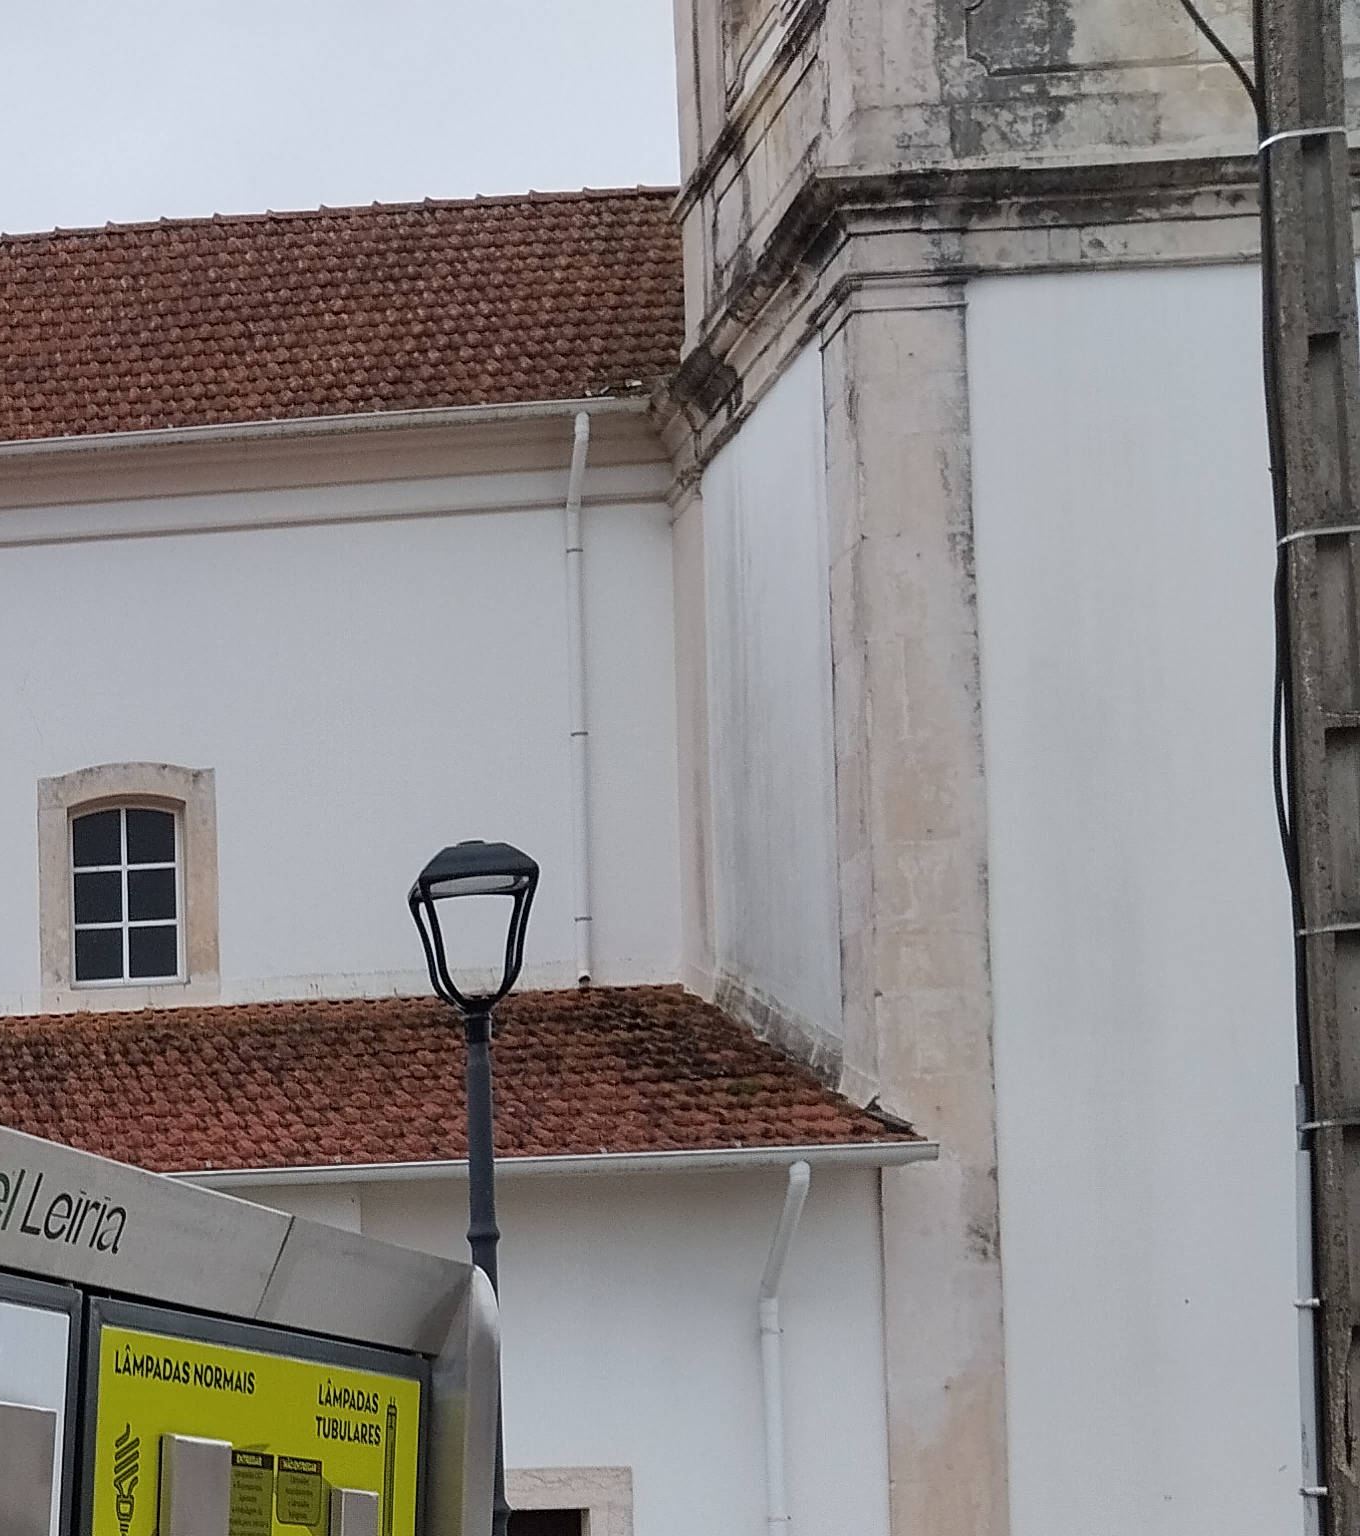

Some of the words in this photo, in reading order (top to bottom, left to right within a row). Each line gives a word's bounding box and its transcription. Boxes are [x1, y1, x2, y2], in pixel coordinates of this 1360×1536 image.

[19, 1169, 128, 1256] Leiria
[114, 1344, 190, 1385] LÂMPADAS
[193, 1364, 256, 1394] NORMAIS
[318, 1379, 379, 1414] LÂMPADAS
[315, 1416, 381, 1446] TUBULARES
